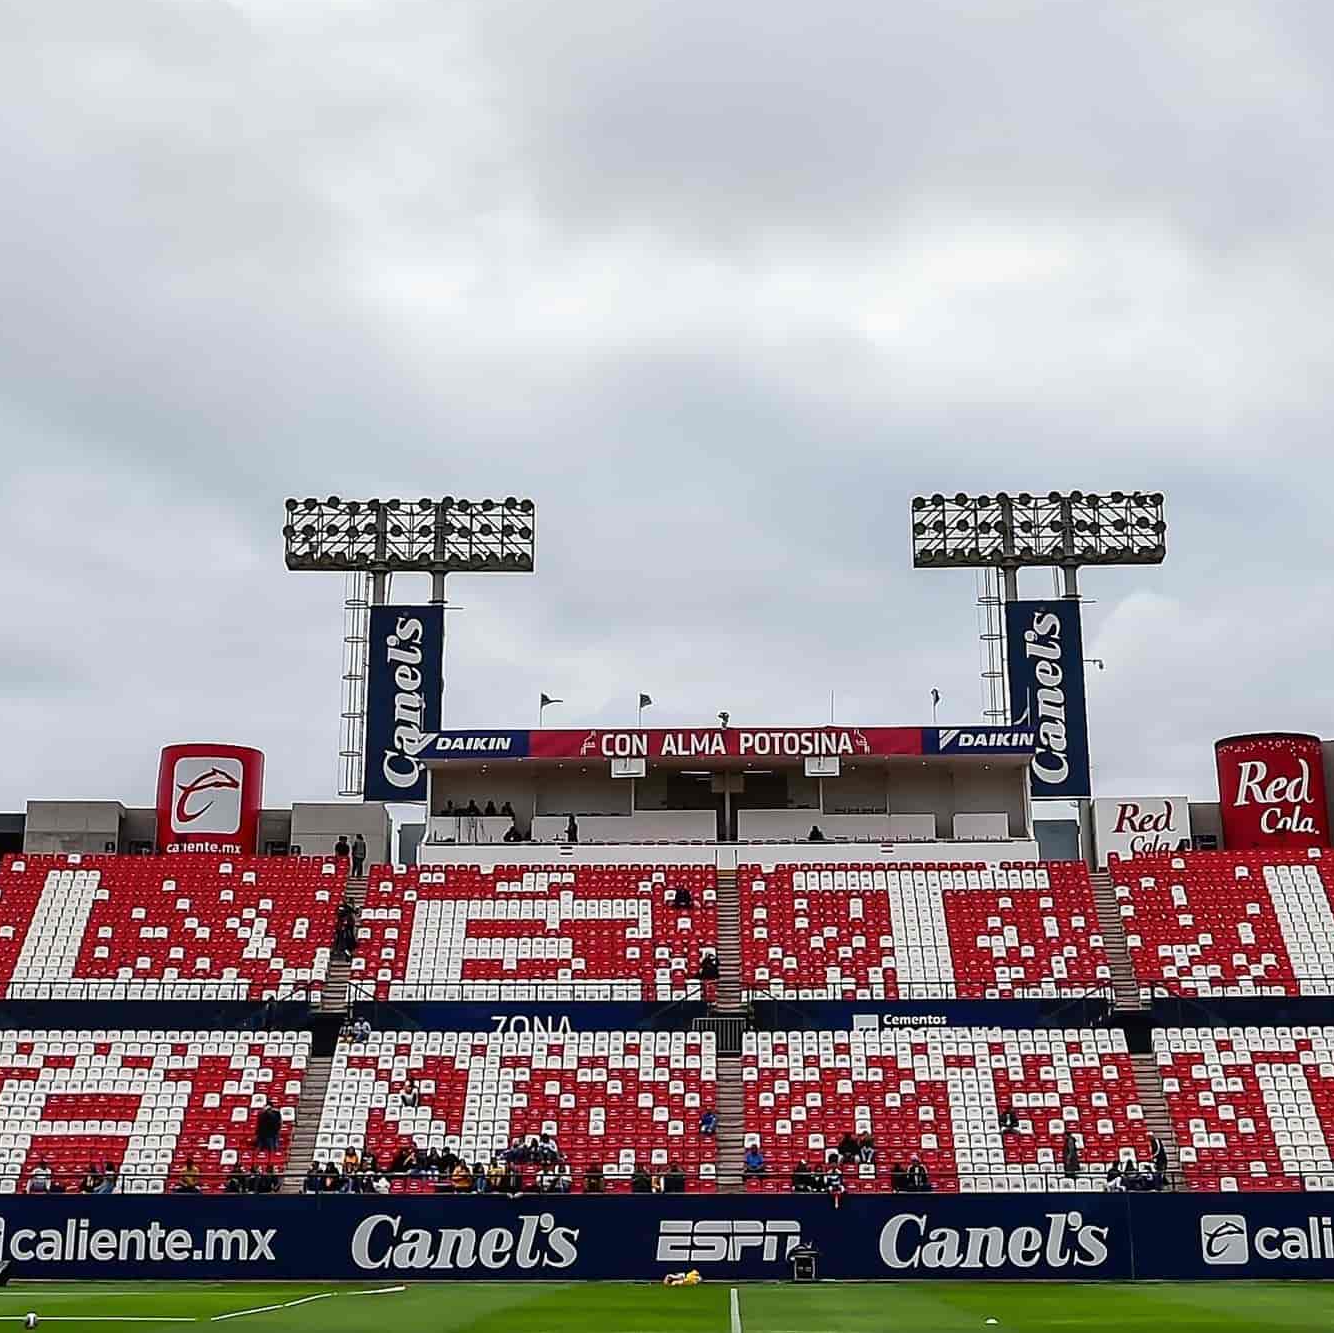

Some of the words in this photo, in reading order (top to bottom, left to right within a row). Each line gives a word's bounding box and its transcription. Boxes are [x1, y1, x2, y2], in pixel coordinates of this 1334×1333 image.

[382, 617, 426, 788] Canel's
[1023, 611, 1070, 784] Canel's
[436, 737, 511, 751] DAIKIN
[601, 733, 648, 757] CON
[660, 733, 727, 756] ALMA
[739, 732, 854, 755] POTOSINA
[958, 732, 1034, 747] DAIKIN
[1233, 758, 1315, 807] Red
[1111, 801, 1177, 834] Red
[166, 842, 243, 855] caiente.mx
[883, 1014, 947, 1025] Cementos
[10, 1219, 277, 1262] caliente.mx
[350, 1213, 581, 1270] Canel's
[656, 1220, 801, 1261] ESPN
[878, 1212, 1110, 1269] Canel's
